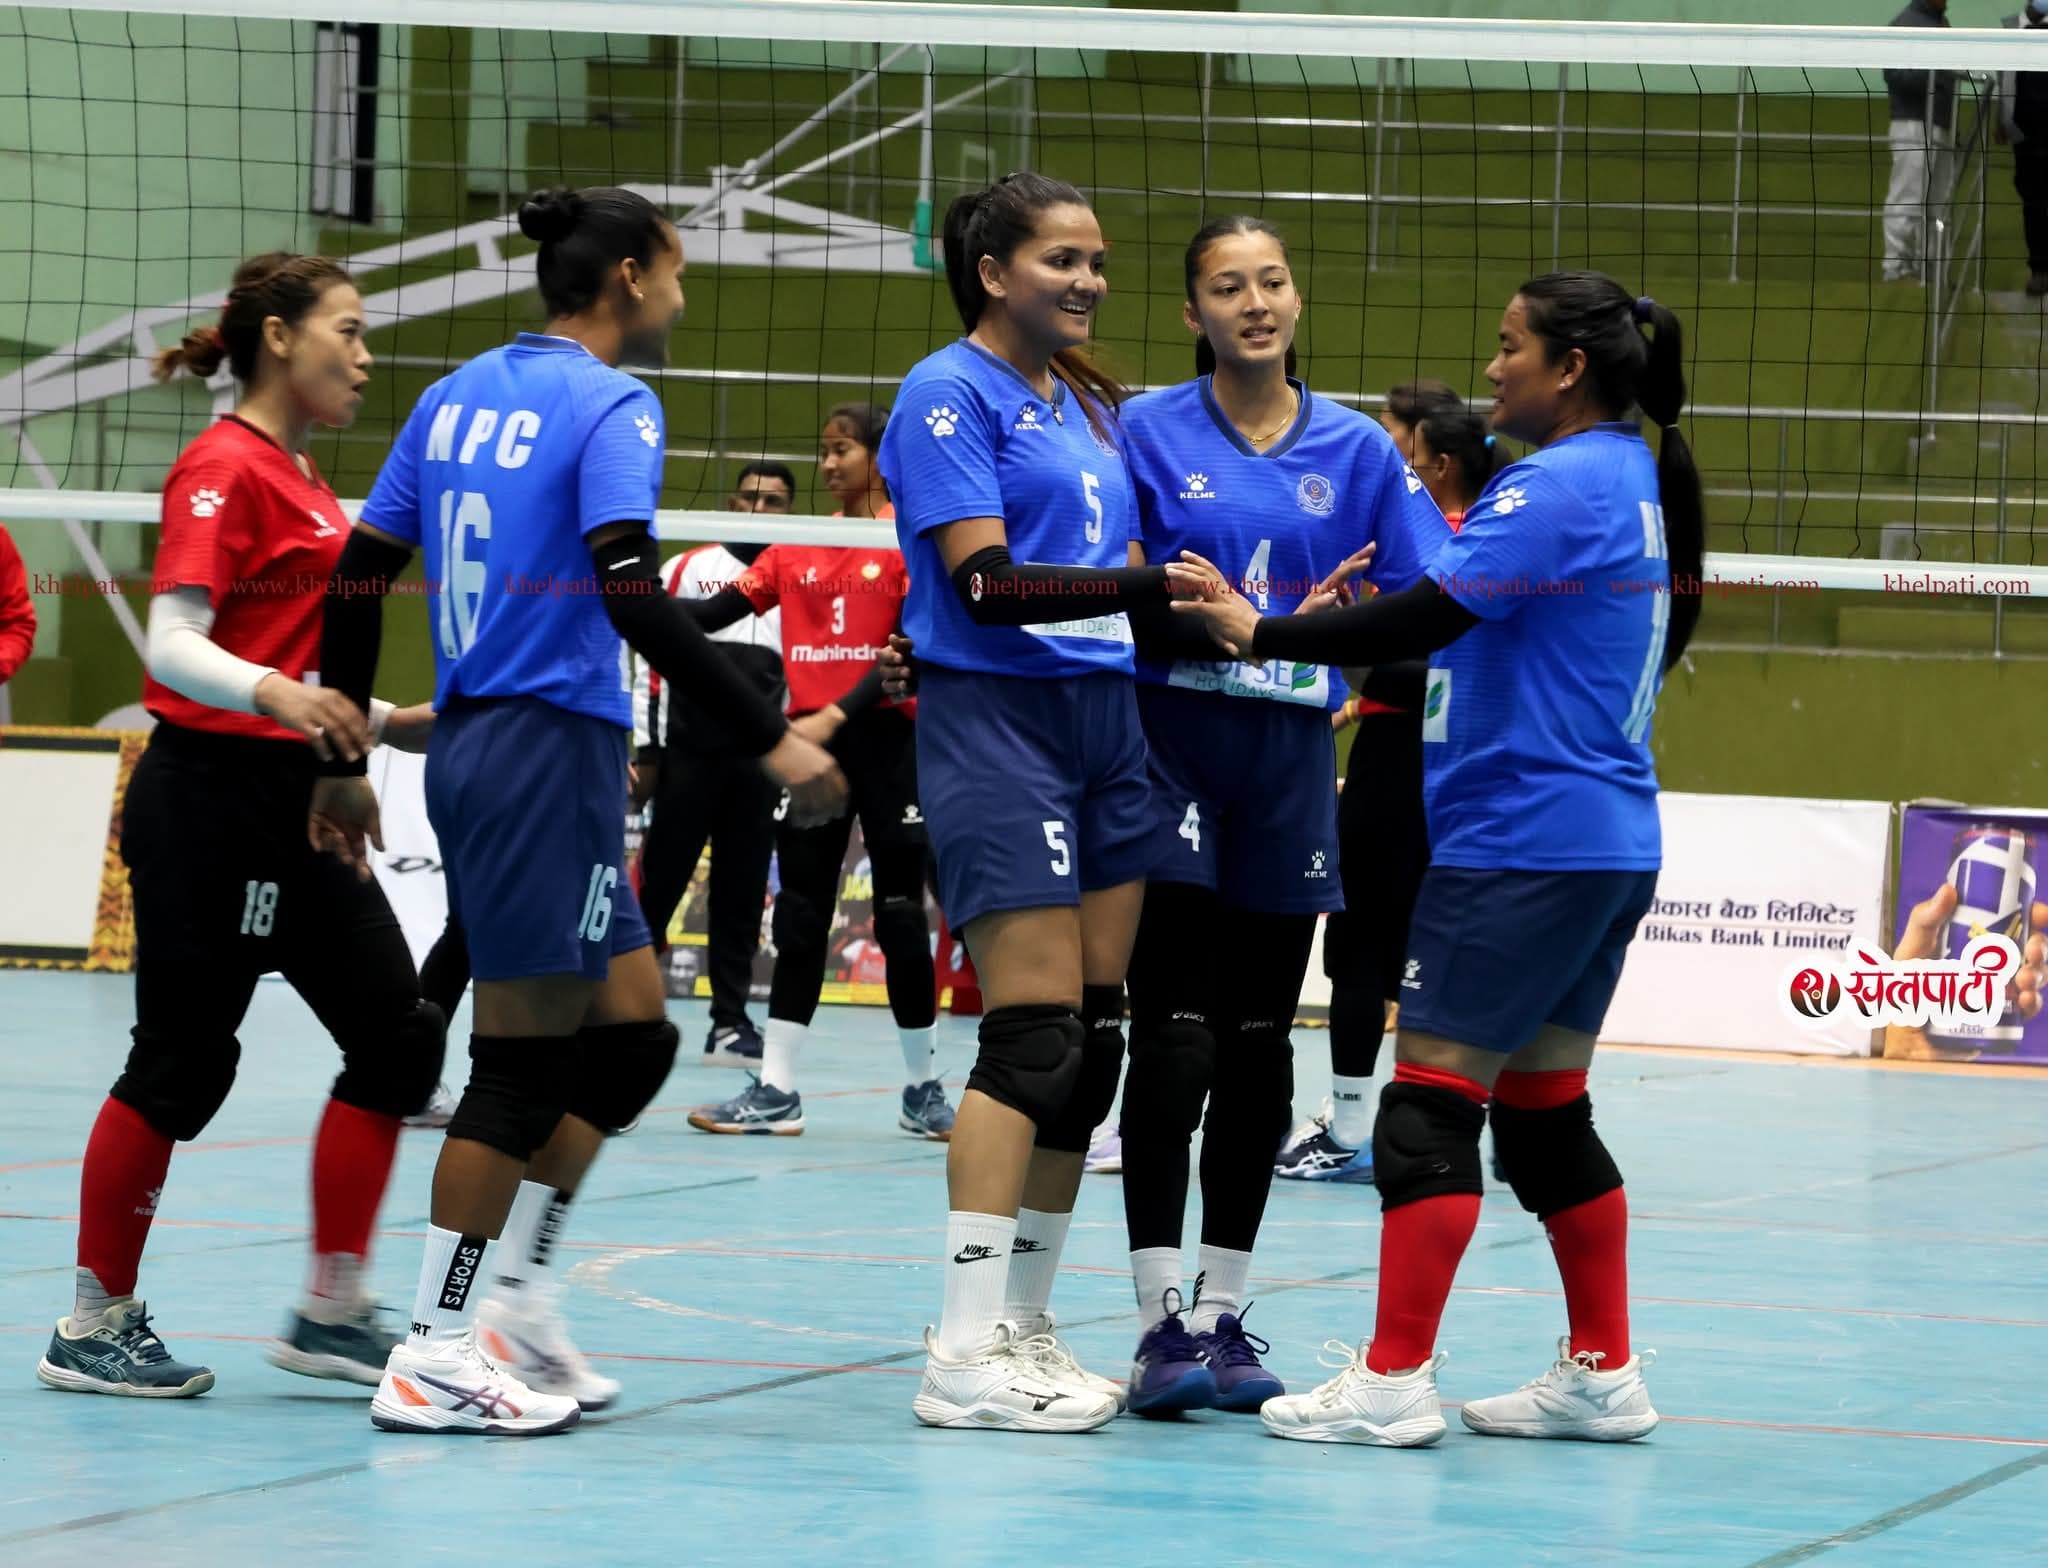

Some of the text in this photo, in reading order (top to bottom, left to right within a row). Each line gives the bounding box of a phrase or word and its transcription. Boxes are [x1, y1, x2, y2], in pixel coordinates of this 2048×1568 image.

[426, 404, 541, 469] NPC
[1081, 471, 1103, 544] 5
[1180, 491, 1216, 499] KELME
[440, 490, 491, 659] 16
[1241, 539, 1271, 609] 4
[831, 597, 844, 634] 3
[792, 643, 881, 662] Mahindr
[1195, 675, 1278, 698] HOLIDAYS
[773, 787, 791, 821] 3
[1178, 802, 1200, 852] 4
[1042, 821, 1071, 876] 5
[240, 880, 279, 936] 18
[578, 864, 617, 941] 16
[1645, 925, 1851, 951] Bikas Bank Limited
[443, 1246, 479, 1306] SPORTS
[962, 1244, 994, 1258] NIKE
